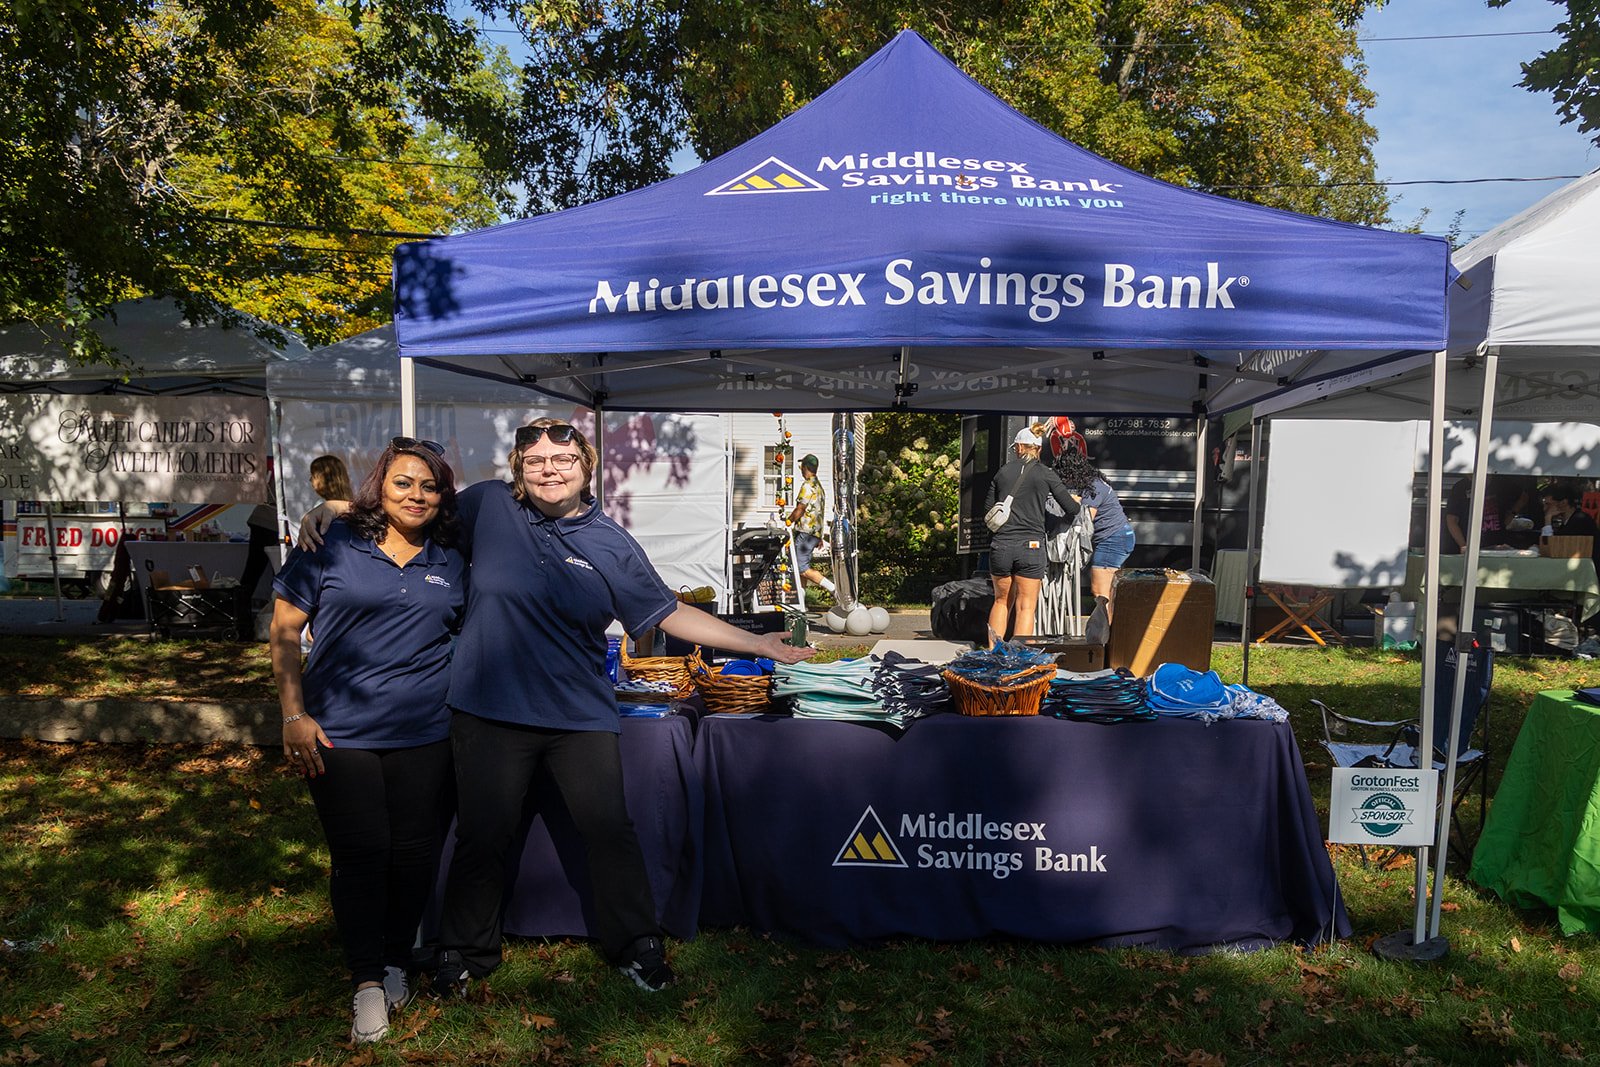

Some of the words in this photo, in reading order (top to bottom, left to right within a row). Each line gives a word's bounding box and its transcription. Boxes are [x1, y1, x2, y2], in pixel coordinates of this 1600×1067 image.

[816, 151, 1029, 174] Middlesex
[841, 170, 998, 191] Savings
[870, 191, 932, 205] right
[940, 192, 1007, 205] there
[1081, 197, 1125, 209] you
[588, 272, 867, 313] Middlesex
[884, 257, 1085, 323] Savings
[138, 421, 215, 443] CANDLES
[220, 421, 254, 443] FOR
[1107, 419, 1171, 429] 617-981-7832
[167, 451, 256, 474] MOMENTS
[22, 526, 83, 548] FRED
[1351, 775, 1419, 788] GrotonFest
[1371, 797, 1396, 808] OFFICIAL
[899, 812, 1047, 841] Middlesex
[1360, 811, 1407, 821] SPONSOR
[917, 843, 1023, 879] Savings
[1034, 846, 1107, 873] Bank
